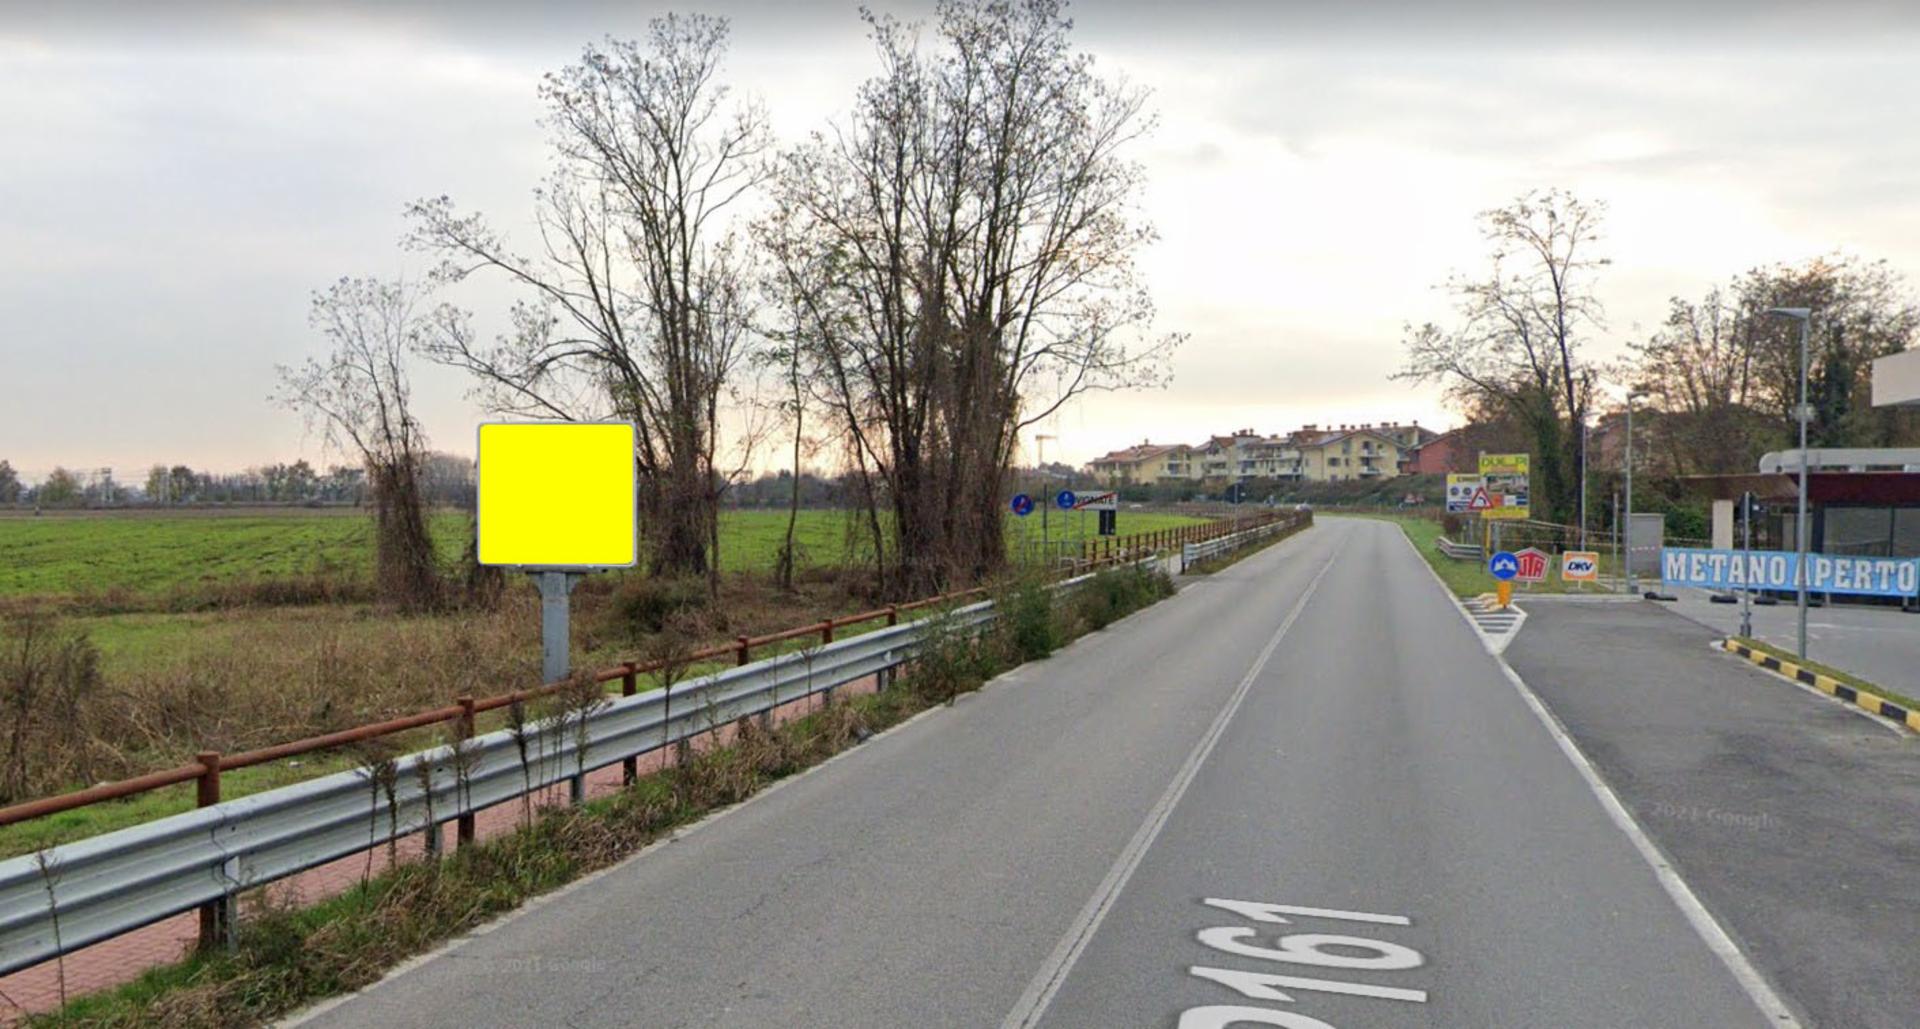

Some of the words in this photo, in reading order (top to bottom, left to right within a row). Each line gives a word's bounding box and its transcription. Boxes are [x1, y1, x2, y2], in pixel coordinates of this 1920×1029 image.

[1567, 560, 1594, 572] DKV
[1664, 551, 1787, 586] METANO
[1793, 556, 1918, 593] APERTO
